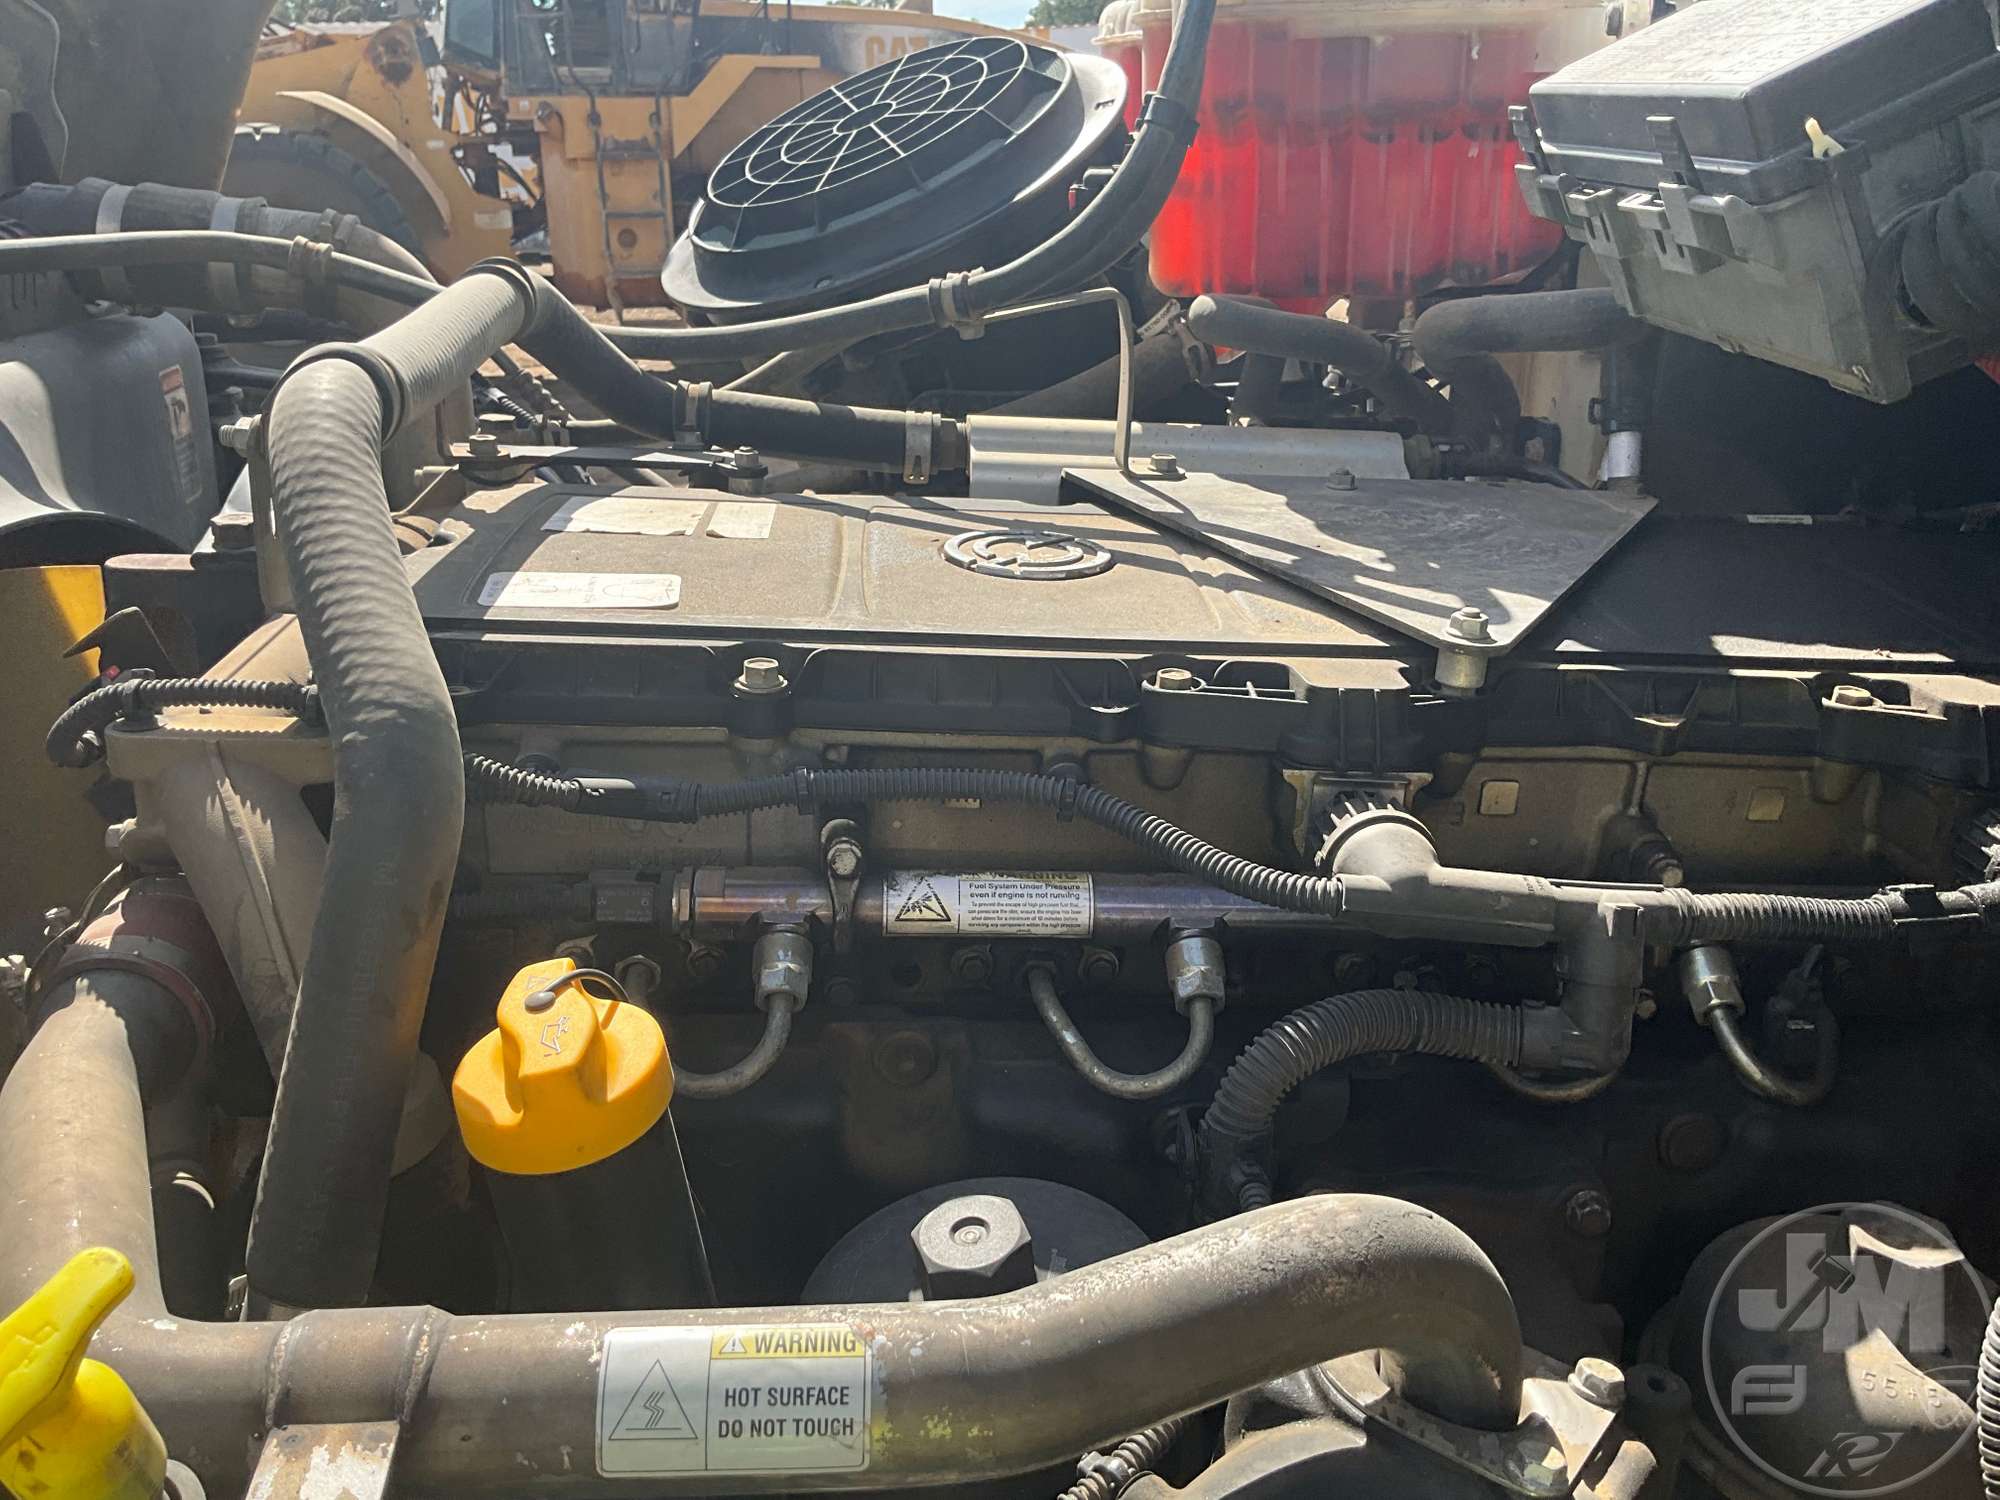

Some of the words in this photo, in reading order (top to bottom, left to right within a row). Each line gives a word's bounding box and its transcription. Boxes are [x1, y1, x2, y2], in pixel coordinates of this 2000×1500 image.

[988, 882, 1018, 891] System
[998, 892, 1025, 900] engine
[1050, 892, 1080, 900] running
[755, 1330, 857, 1354] WARNING
[724, 1387, 761, 1408] HOT
[767, 1386, 850, 1407] SURFACE
[718, 1419, 744, 1439] DO
[750, 1418, 787, 1438] NOT
[792, 1417, 855, 1438] TOUCH
